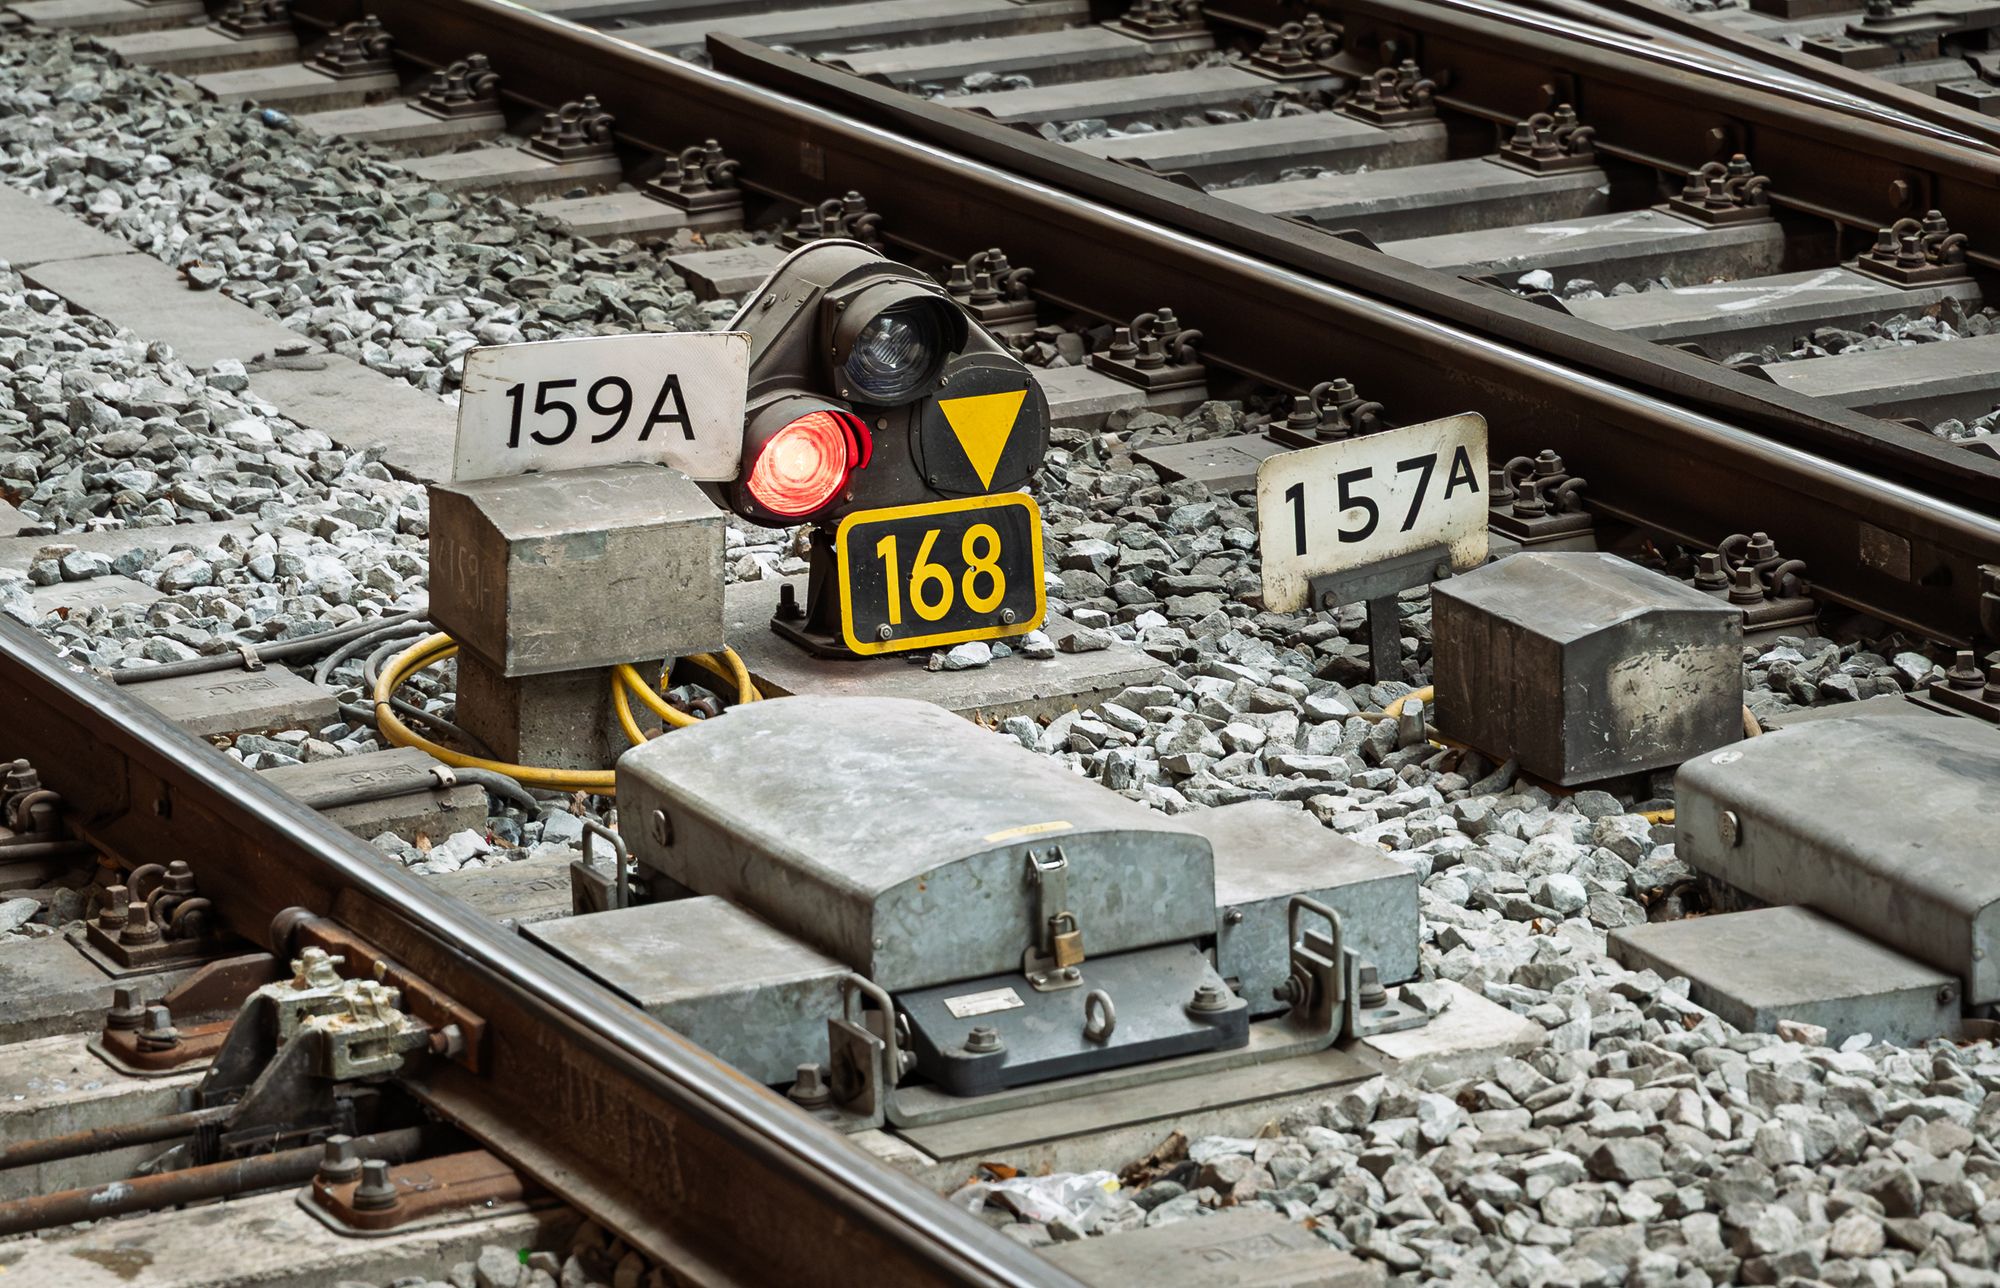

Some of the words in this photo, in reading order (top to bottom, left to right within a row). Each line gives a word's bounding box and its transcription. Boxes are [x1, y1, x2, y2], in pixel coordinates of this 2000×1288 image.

[505, 373, 696, 449] 159A
[1285, 445, 1480, 557] 157A
[876, 523, 1006, 625] 168
